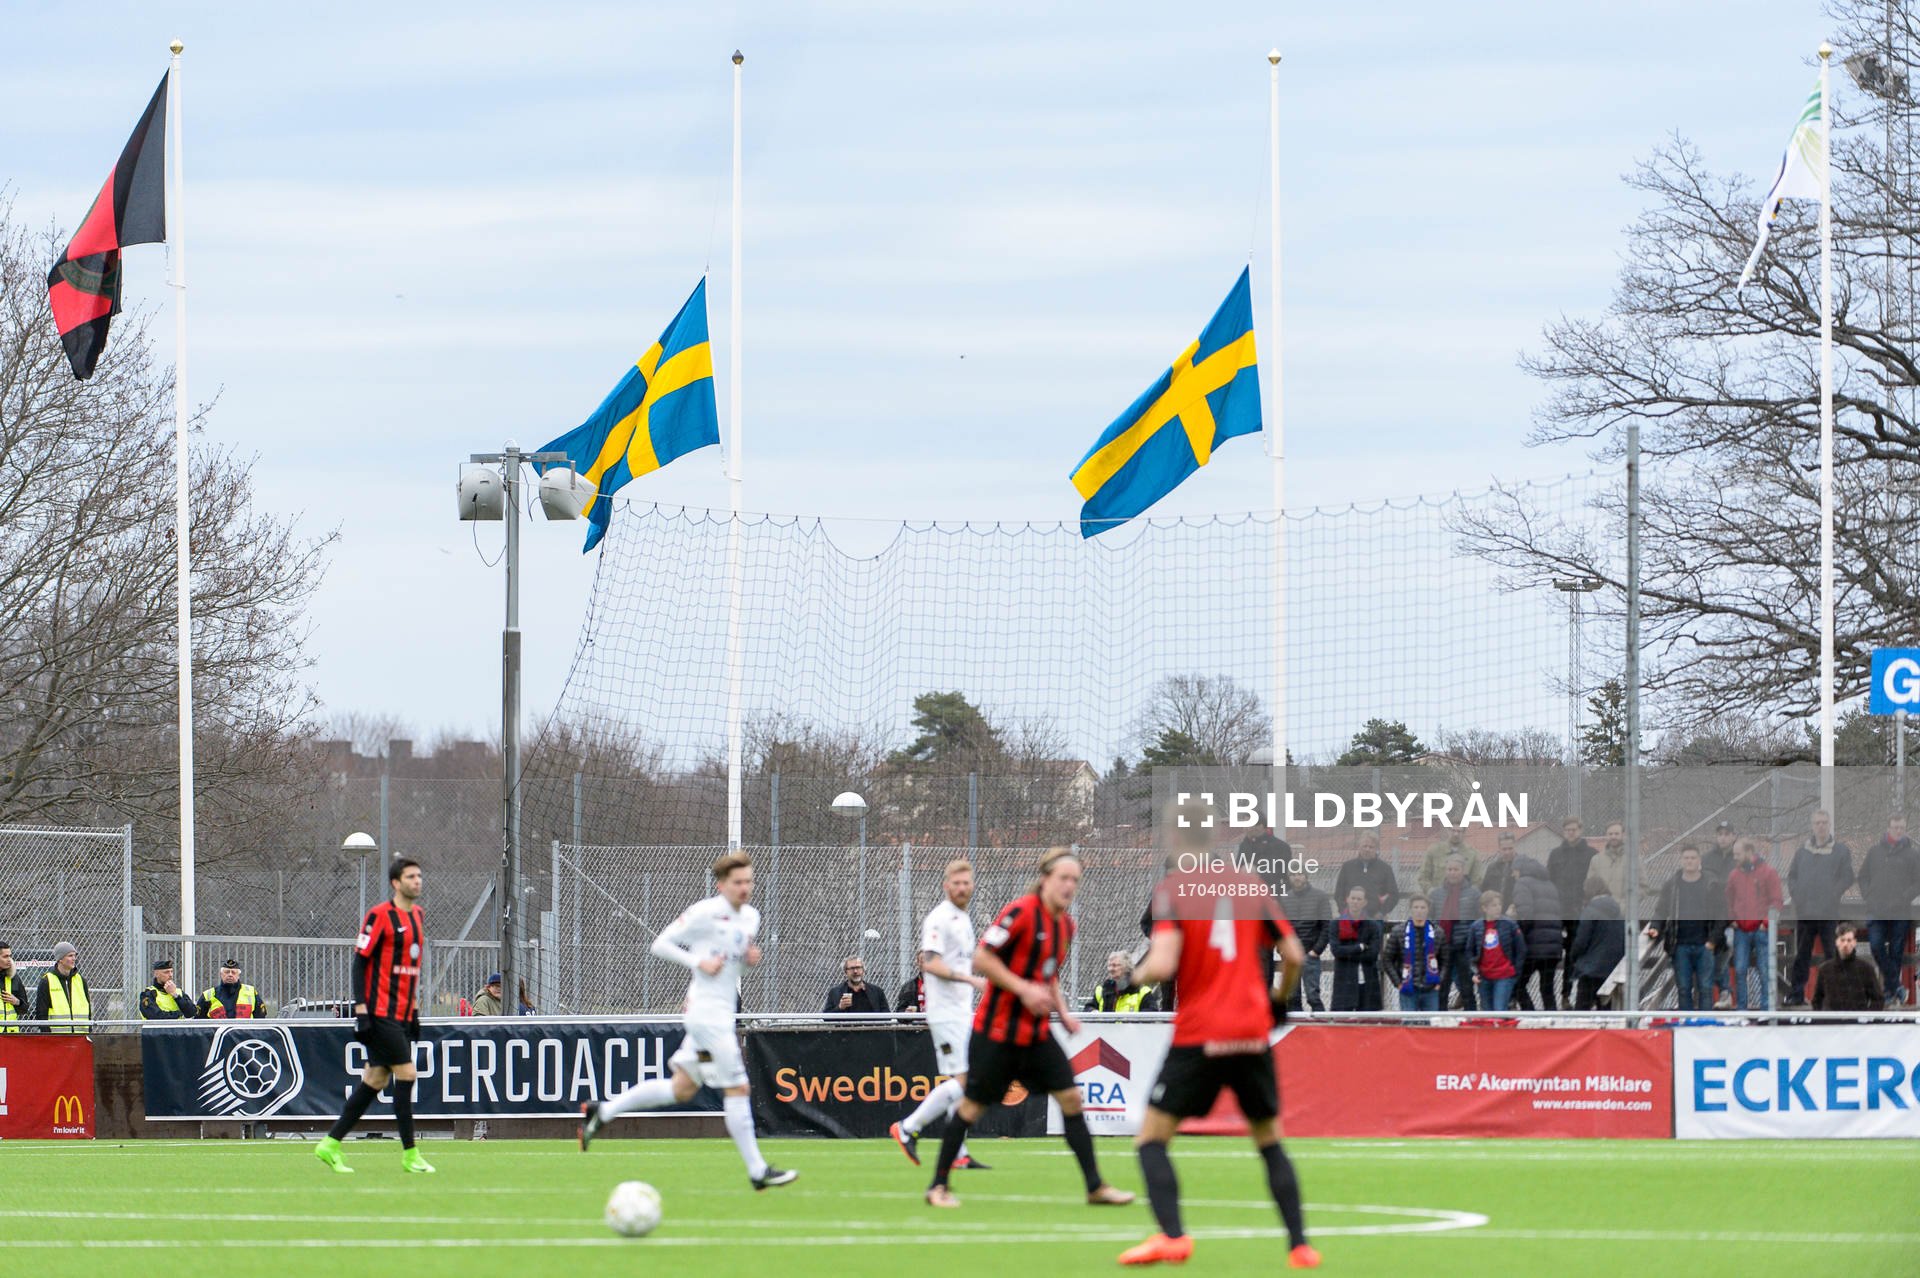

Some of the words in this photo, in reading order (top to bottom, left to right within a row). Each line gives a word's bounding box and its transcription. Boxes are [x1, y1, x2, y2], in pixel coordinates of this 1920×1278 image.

[1208, 893, 1238, 963] 4
[345, 1036, 664, 1104] SPERCOACH
[1477, 1073, 1581, 1093] Åkermyntan
[1585, 1075, 1652, 1092] Mäklare
[1693, 1057, 1920, 1112] ECKER
[1532, 1099, 1652, 1111] www.erasweden.com
